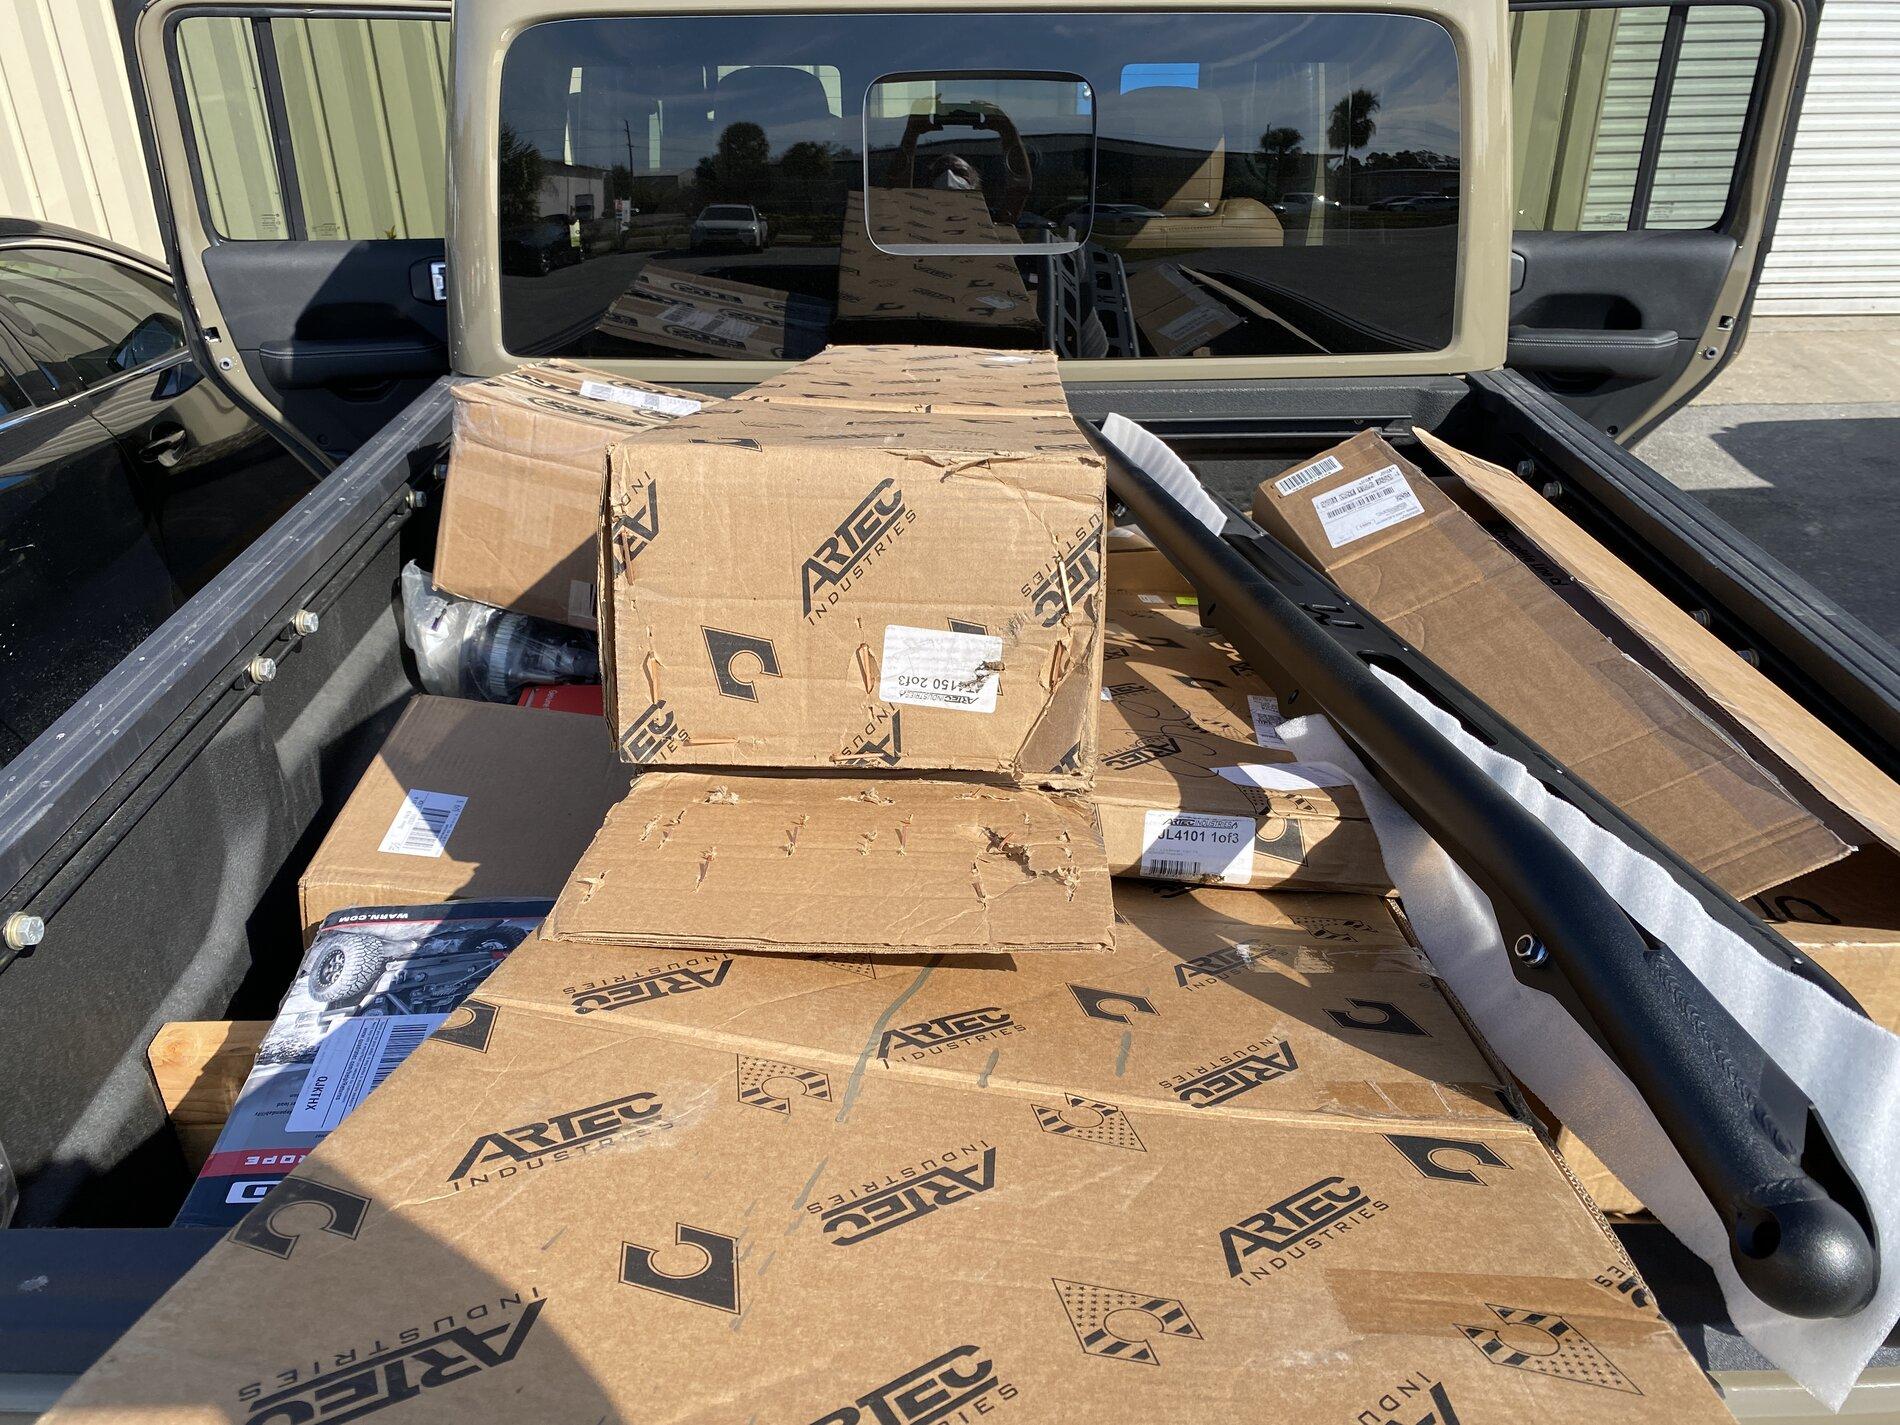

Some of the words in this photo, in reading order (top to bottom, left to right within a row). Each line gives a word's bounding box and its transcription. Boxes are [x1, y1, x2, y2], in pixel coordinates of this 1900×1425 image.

[802, 478, 905, 618] ARTEC
[808, 509, 916, 625] INDUSTRIES
[1021, 514, 1100, 597] USTRIES
[898, 675, 928, 688] 2of3
[944, 694, 979, 704] ARTEC
[1101, 737, 1182, 770] ARTEC
[1158, 828, 1205, 842] JL4101
[1211, 831, 1239, 844] 1of3
[1163, 818, 1195, 827] ARTEC
[338, 912, 409, 923] WARN.COM
[563, 953, 729, 995] INDUSTRIES
[571, 959, 734, 1014] ARTEC
[877, 1006, 1014, 1060] ARTEC
[1159, 1035, 1280, 1089] INDUSTRIES
[1173, 1040, 1298, 1109] ARTEC
[305, 1076, 328, 1111] QJKTHX
[446, 1091, 663, 1182] ARTEC
[806, 1140, 989, 1215] INDUSTRIES
[821, 1146, 996, 1246] ARTEC
[1219, 1176, 1371, 1278] ARTEC
[1239, 1200, 1389, 1286] INDUSTRIES
[238, 1286, 539, 1402] INDUSTRIES
